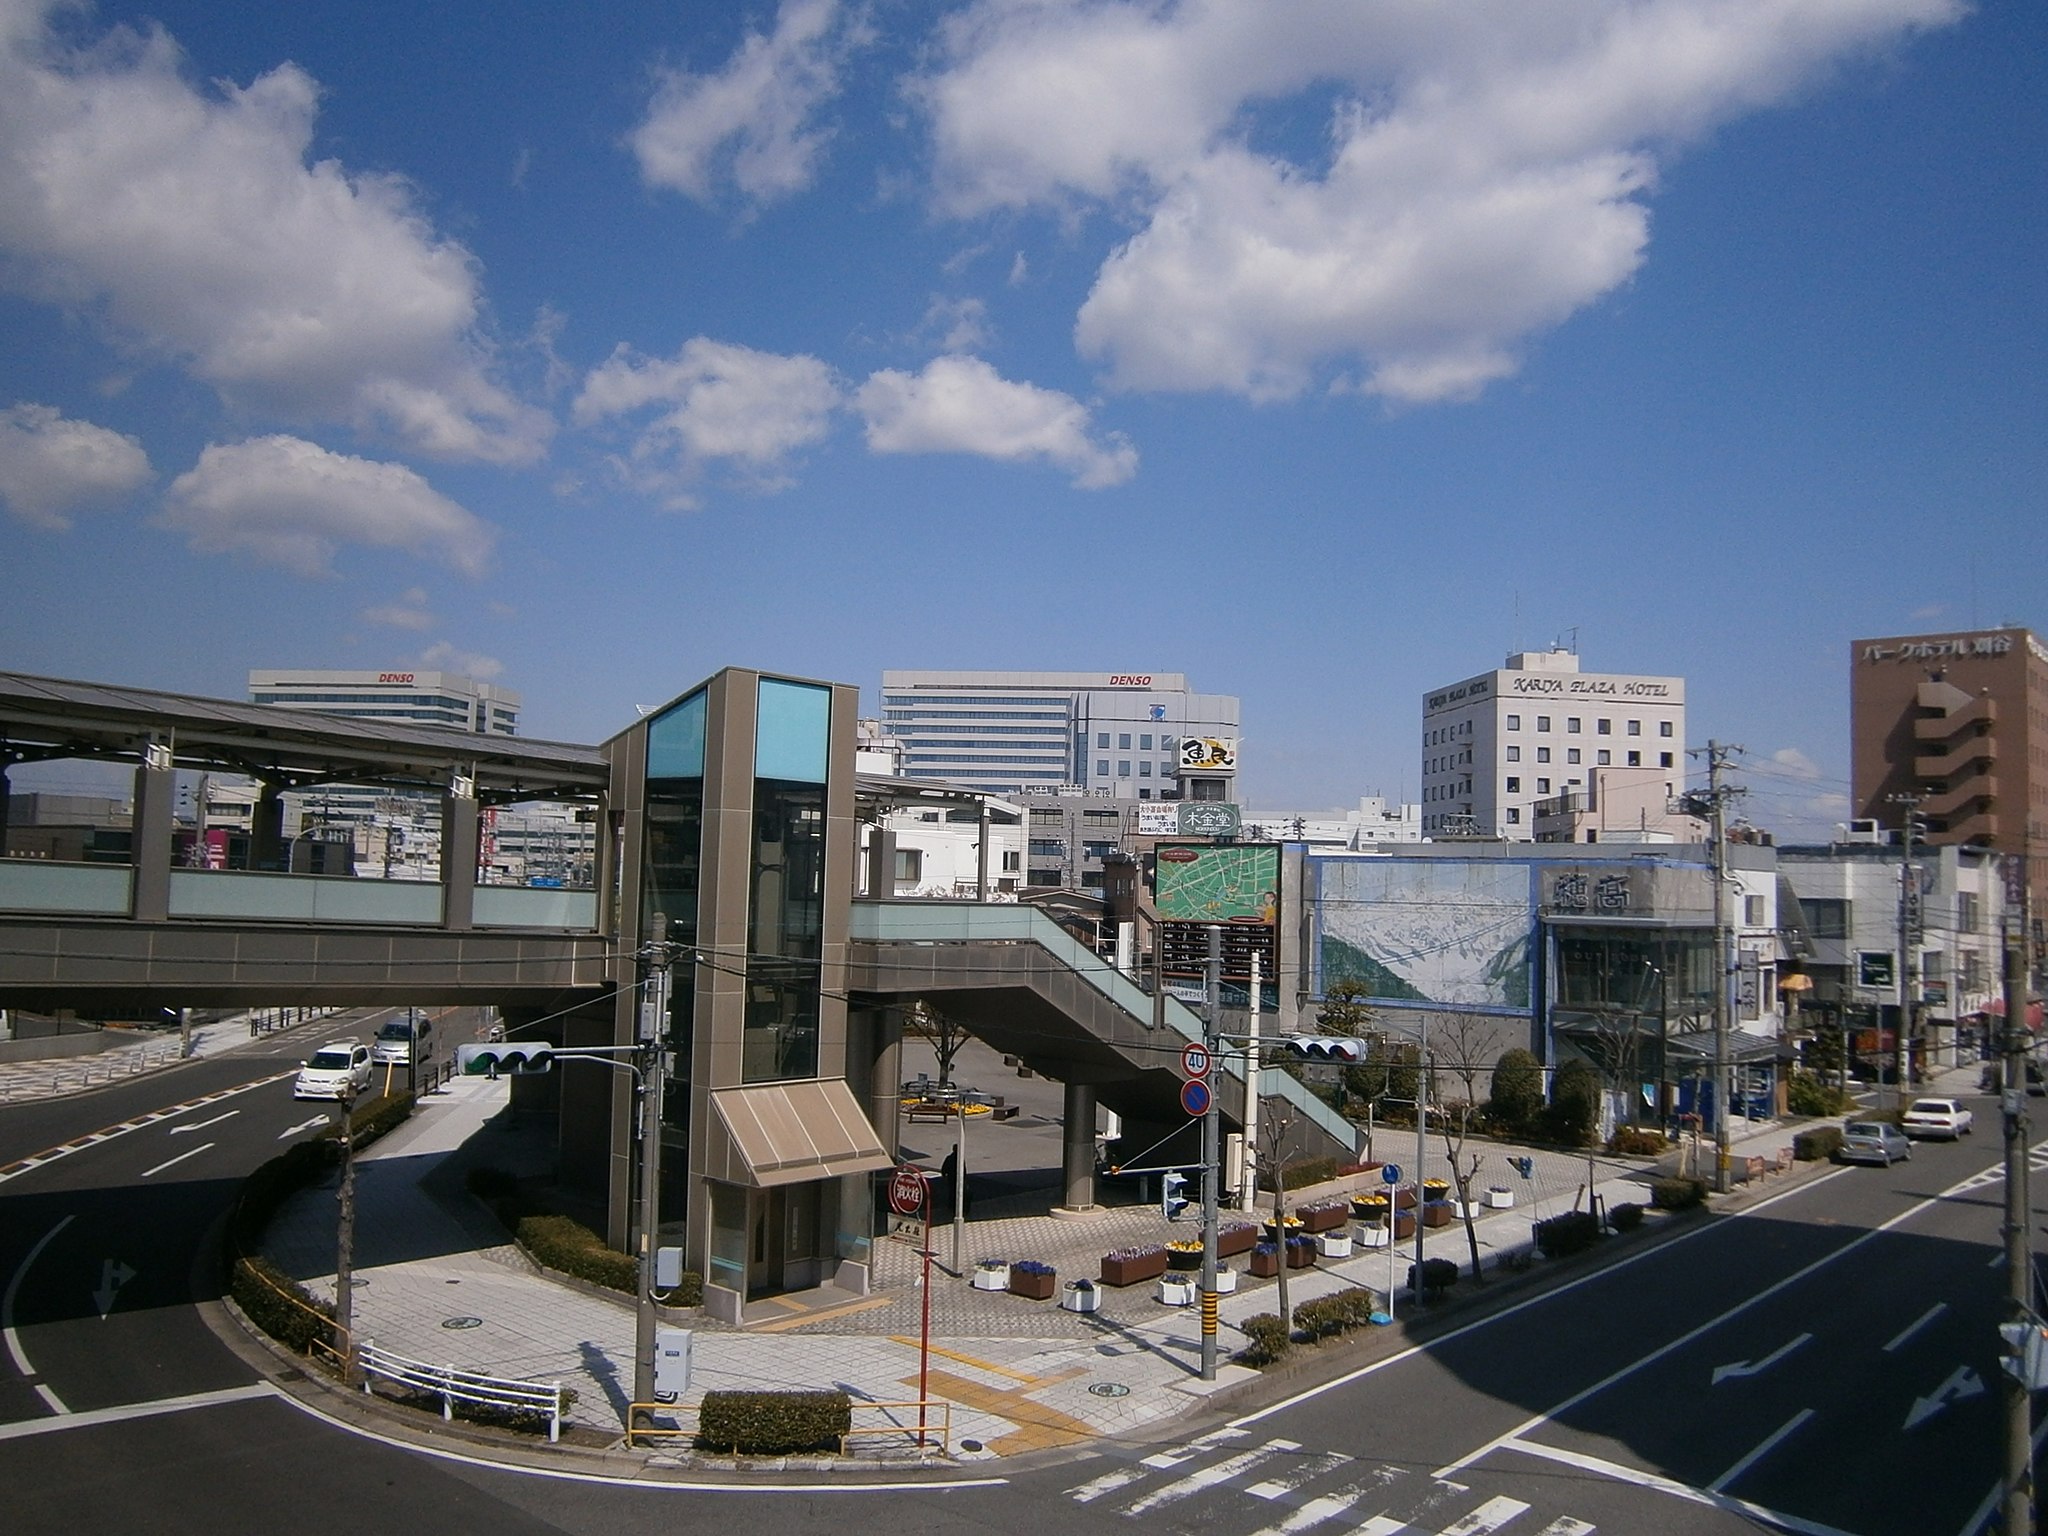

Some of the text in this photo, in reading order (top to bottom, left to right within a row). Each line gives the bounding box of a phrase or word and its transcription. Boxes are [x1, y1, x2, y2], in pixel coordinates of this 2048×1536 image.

[1863, 639, 1967, 661] パークホテル
[1974, 634, 2012, 654] 刈谷
[378, 673, 415, 684] DENSO
[1110, 675, 1151, 686] DENSO
[1513, 677, 1669, 697] KARIYA PLAZA HOTEL
[1428, 679, 1489, 710] KARIYA PLAZA HOTEL
[1181, 739, 1234, 766] 魚民
[1185, 811, 1231, 827] 木金堂
[1188, 1052, 1204, 1068] 40
[897, 1184, 920, 1202] 消火栓
